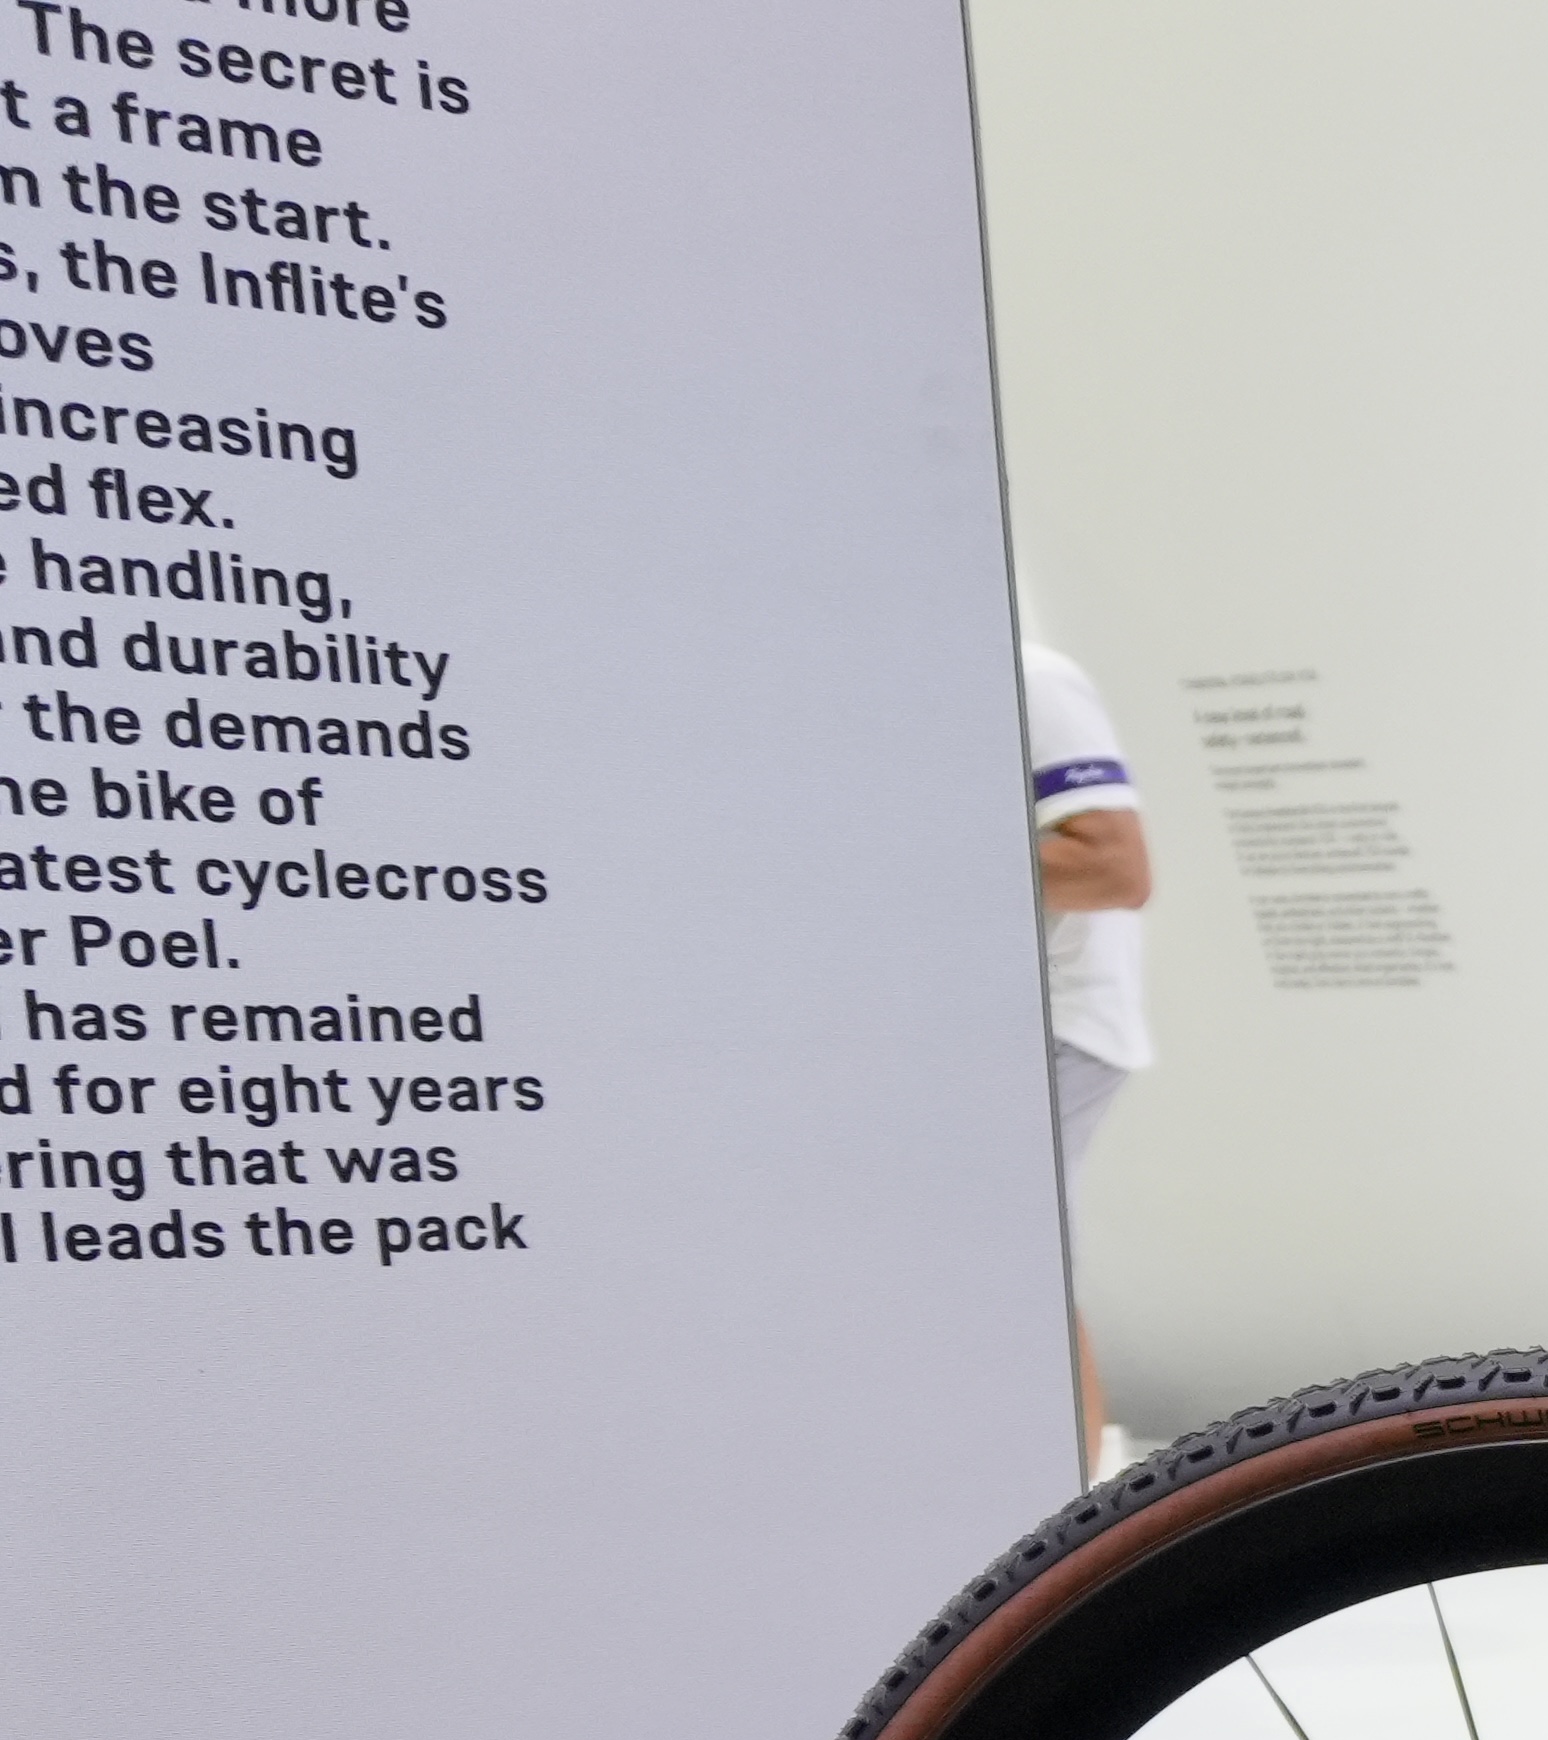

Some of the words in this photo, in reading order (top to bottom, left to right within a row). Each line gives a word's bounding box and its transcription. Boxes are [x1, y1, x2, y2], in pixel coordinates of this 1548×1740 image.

[16, 0, 154, 70] The
[177, 38, 397, 105] secret
[417, 60, 470, 114] is
[54, 96, 90, 138] a
[111, 92, 322, 167] frame
[62, 163, 180, 224] the
[203, 188, 390, 250] start.
[59, 239, 178, 299] the
[200, 251, 447, 329] Inflite's
[88, 467, 234, 529] flex.
[31, 537, 351, 623] handling,
[0, 616, 98, 668] nd
[123, 621, 450, 701] durability
[22, 690, 141, 745] the
[165, 698, 470, 761] demands
[91, 767, 236, 823] bike
[259, 777, 324, 826] of
[196, 849, 548, 910] cyclecross
[70, 915, 240, 969] Poel.
[24, 989, 147, 1041] has
[171, 994, 483, 1042] remained
[52, 1064, 156, 1114] for
[179, 1064, 352, 1127] eight
[367, 1076, 544, 1126] years
[164, 1136, 308, 1186] that
[324, 1146, 459, 1183] was
[41, 1209, 226, 1262] leads
[244, 1207, 354, 1256] the
[375, 1202, 529, 1266] pack
